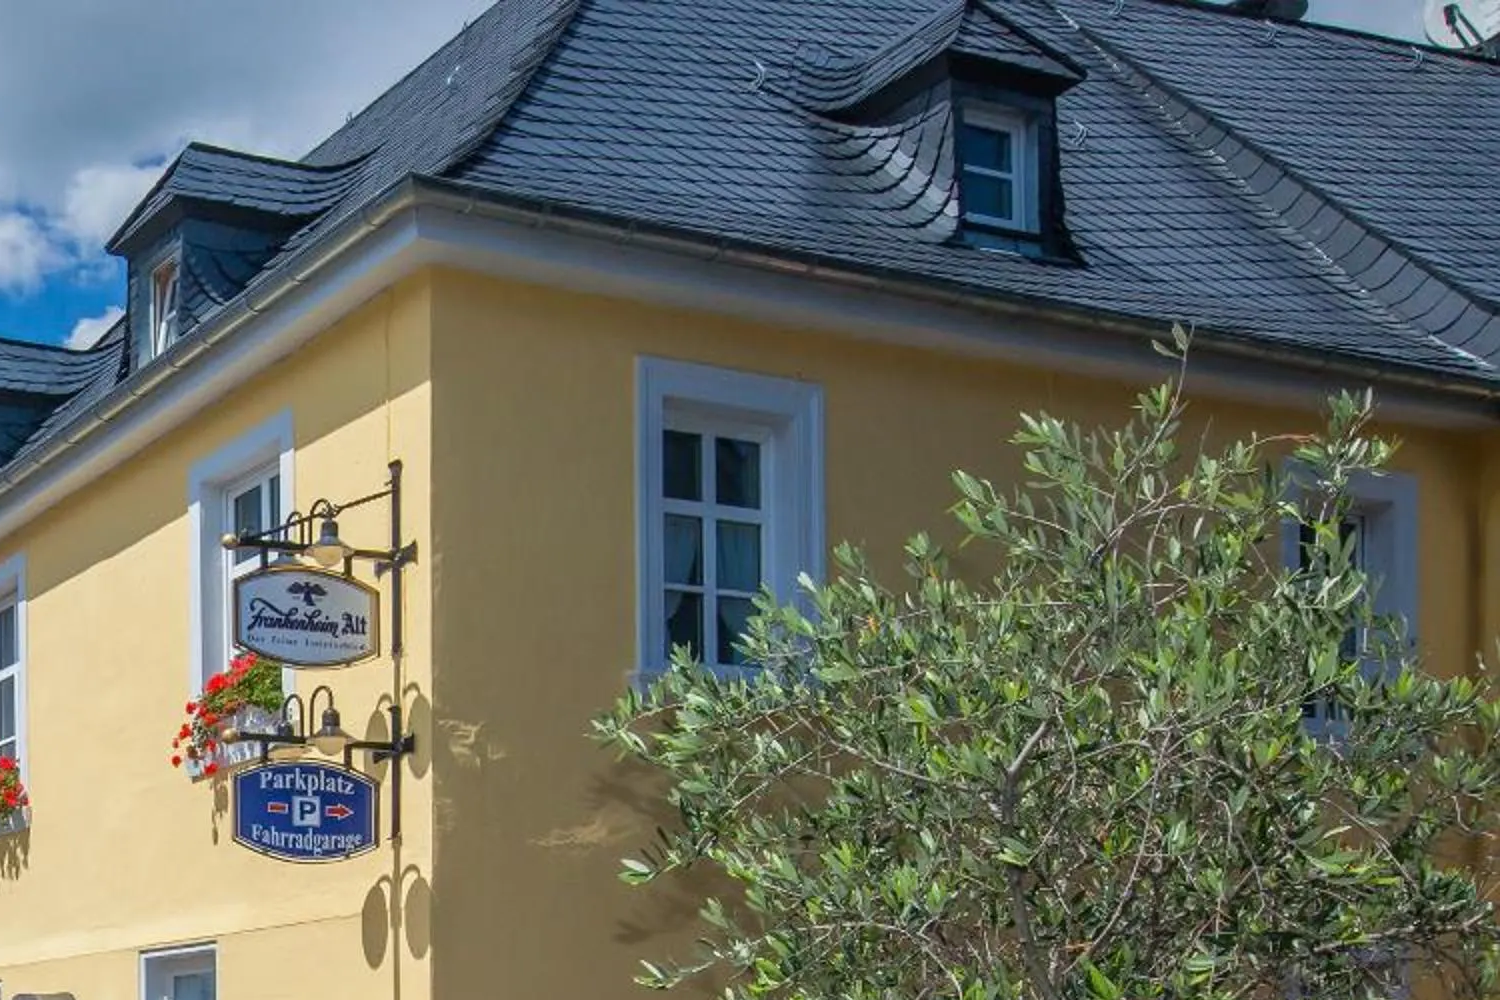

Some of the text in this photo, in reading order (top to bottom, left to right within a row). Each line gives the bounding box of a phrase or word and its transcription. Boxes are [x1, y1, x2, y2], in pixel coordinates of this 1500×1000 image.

[247, 597, 368, 639] Frankenheim Alt
[259, 767, 356, 797] Parkplatz
[299, 800, 317, 821] P
[250, 822, 363, 857] Fahrradgarage
